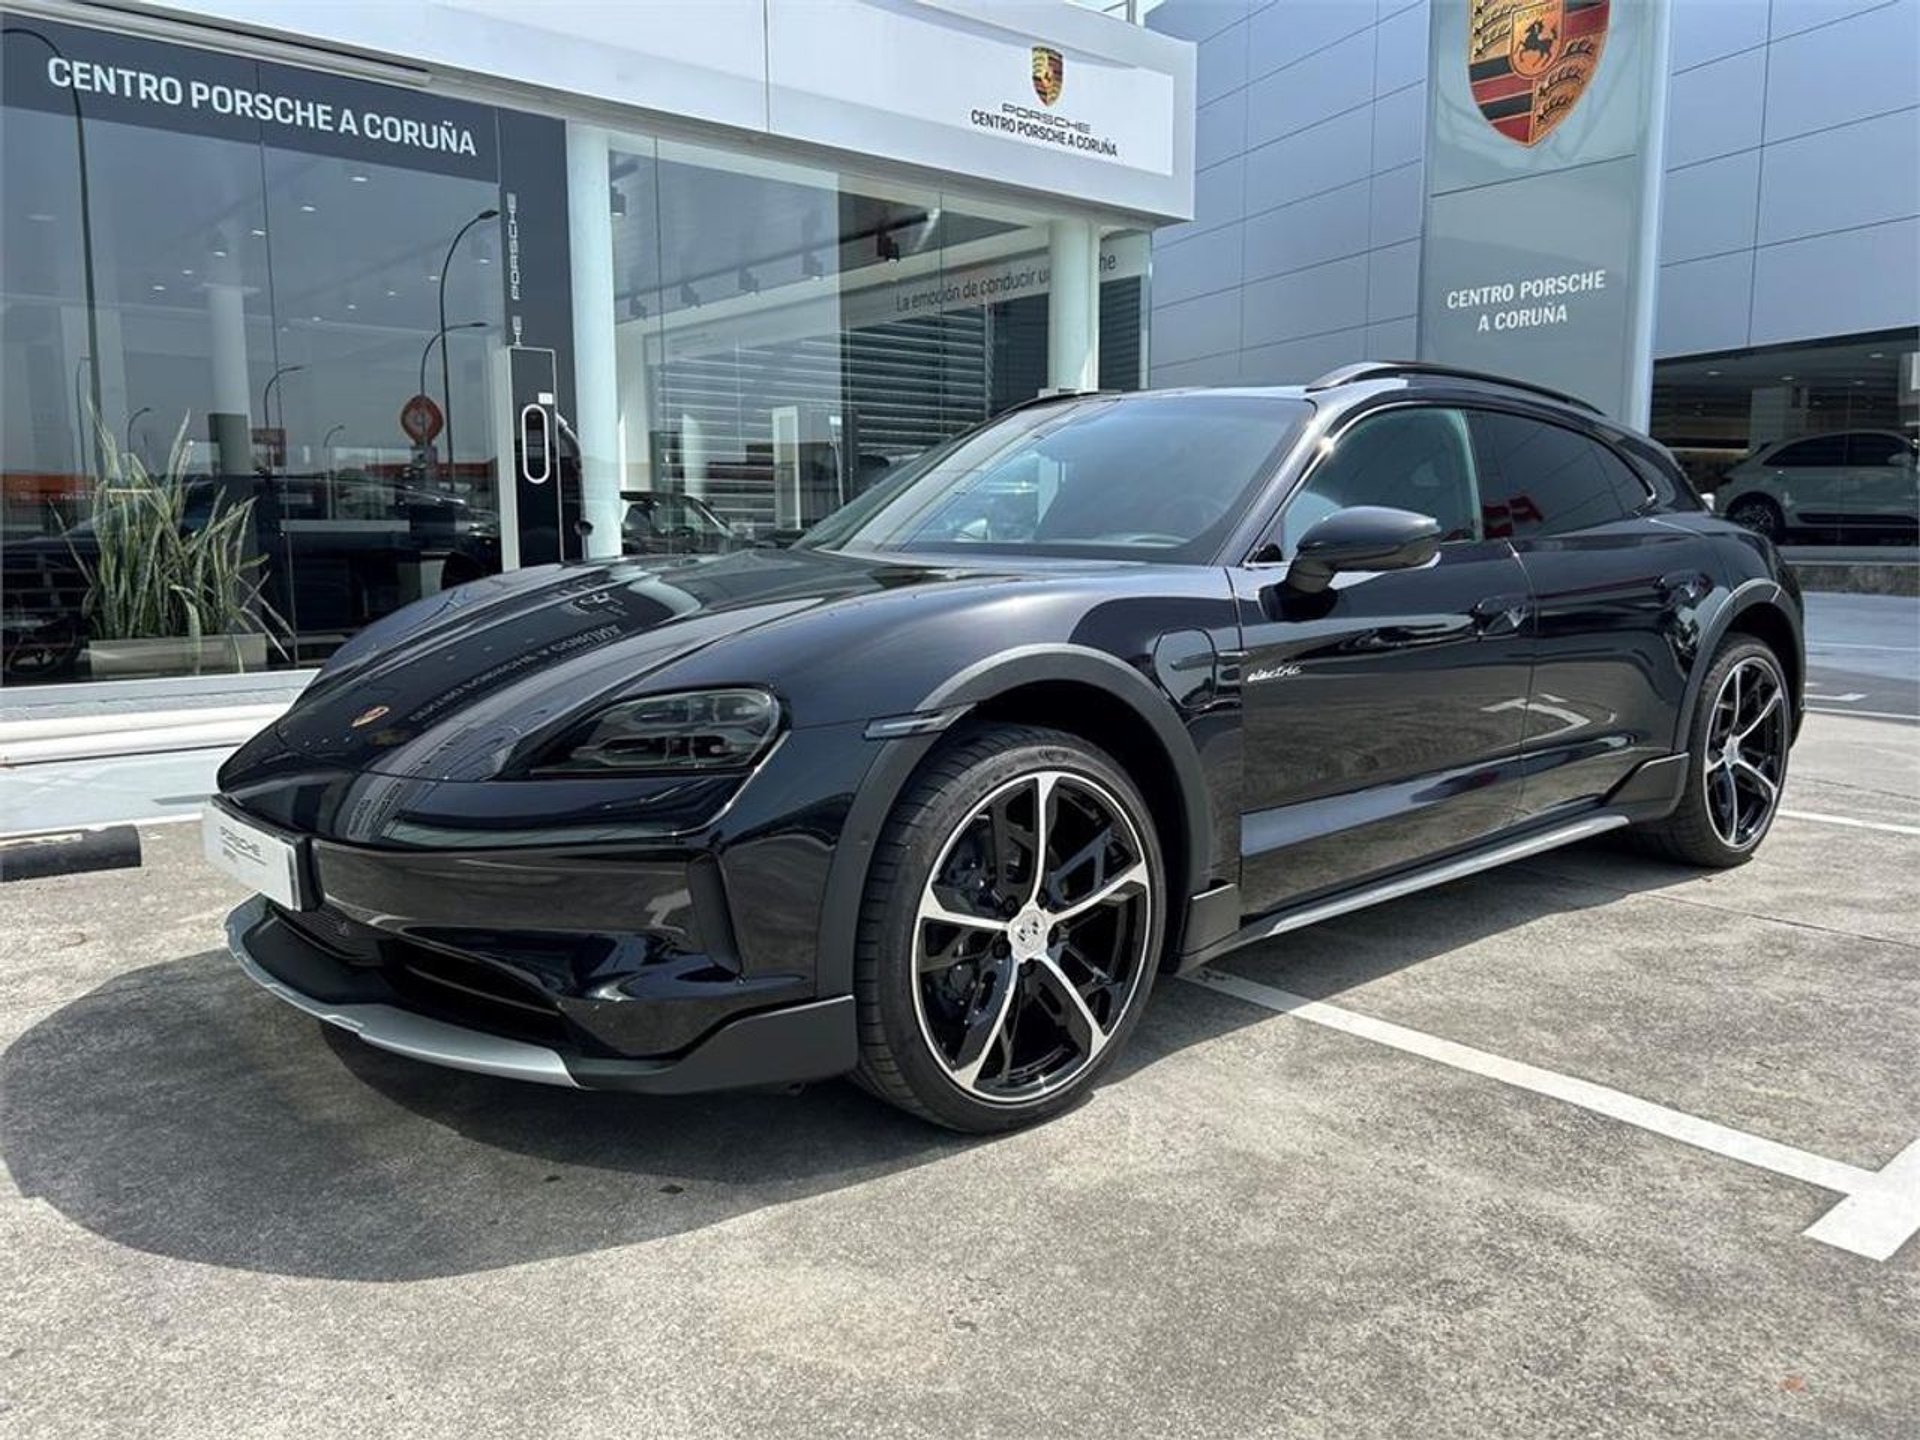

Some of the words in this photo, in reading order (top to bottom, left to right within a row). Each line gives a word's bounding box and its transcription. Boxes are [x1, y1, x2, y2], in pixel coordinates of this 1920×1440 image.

[48, 57, 182, 105] CENTRO
[191, 82, 334, 131] PORSCHE
[339, 108, 359, 135] A
[364, 113, 477, 156] CORUÑA
[1002, 103, 1091, 134] PORSCHE
[971, 109, 1016, 133] CENTRO
[1017, 121, 1067, 145] PORSCHE
[1068, 133, 1075, 148] A
[1077, 135, 1118, 156] CORUÑA
[506, 192, 520, 300] PORSCHE
[963, 279, 978, 299] de
[980, 268, 1036, 296] conducir
[1447, 283, 1514, 309] CENTRO
[1520, 270, 1606, 300] PORSCHE
[1478, 314, 1489, 332] A
[1495, 301, 1568, 330] CORUÑA
[1247, 664, 1303, 682] electric
